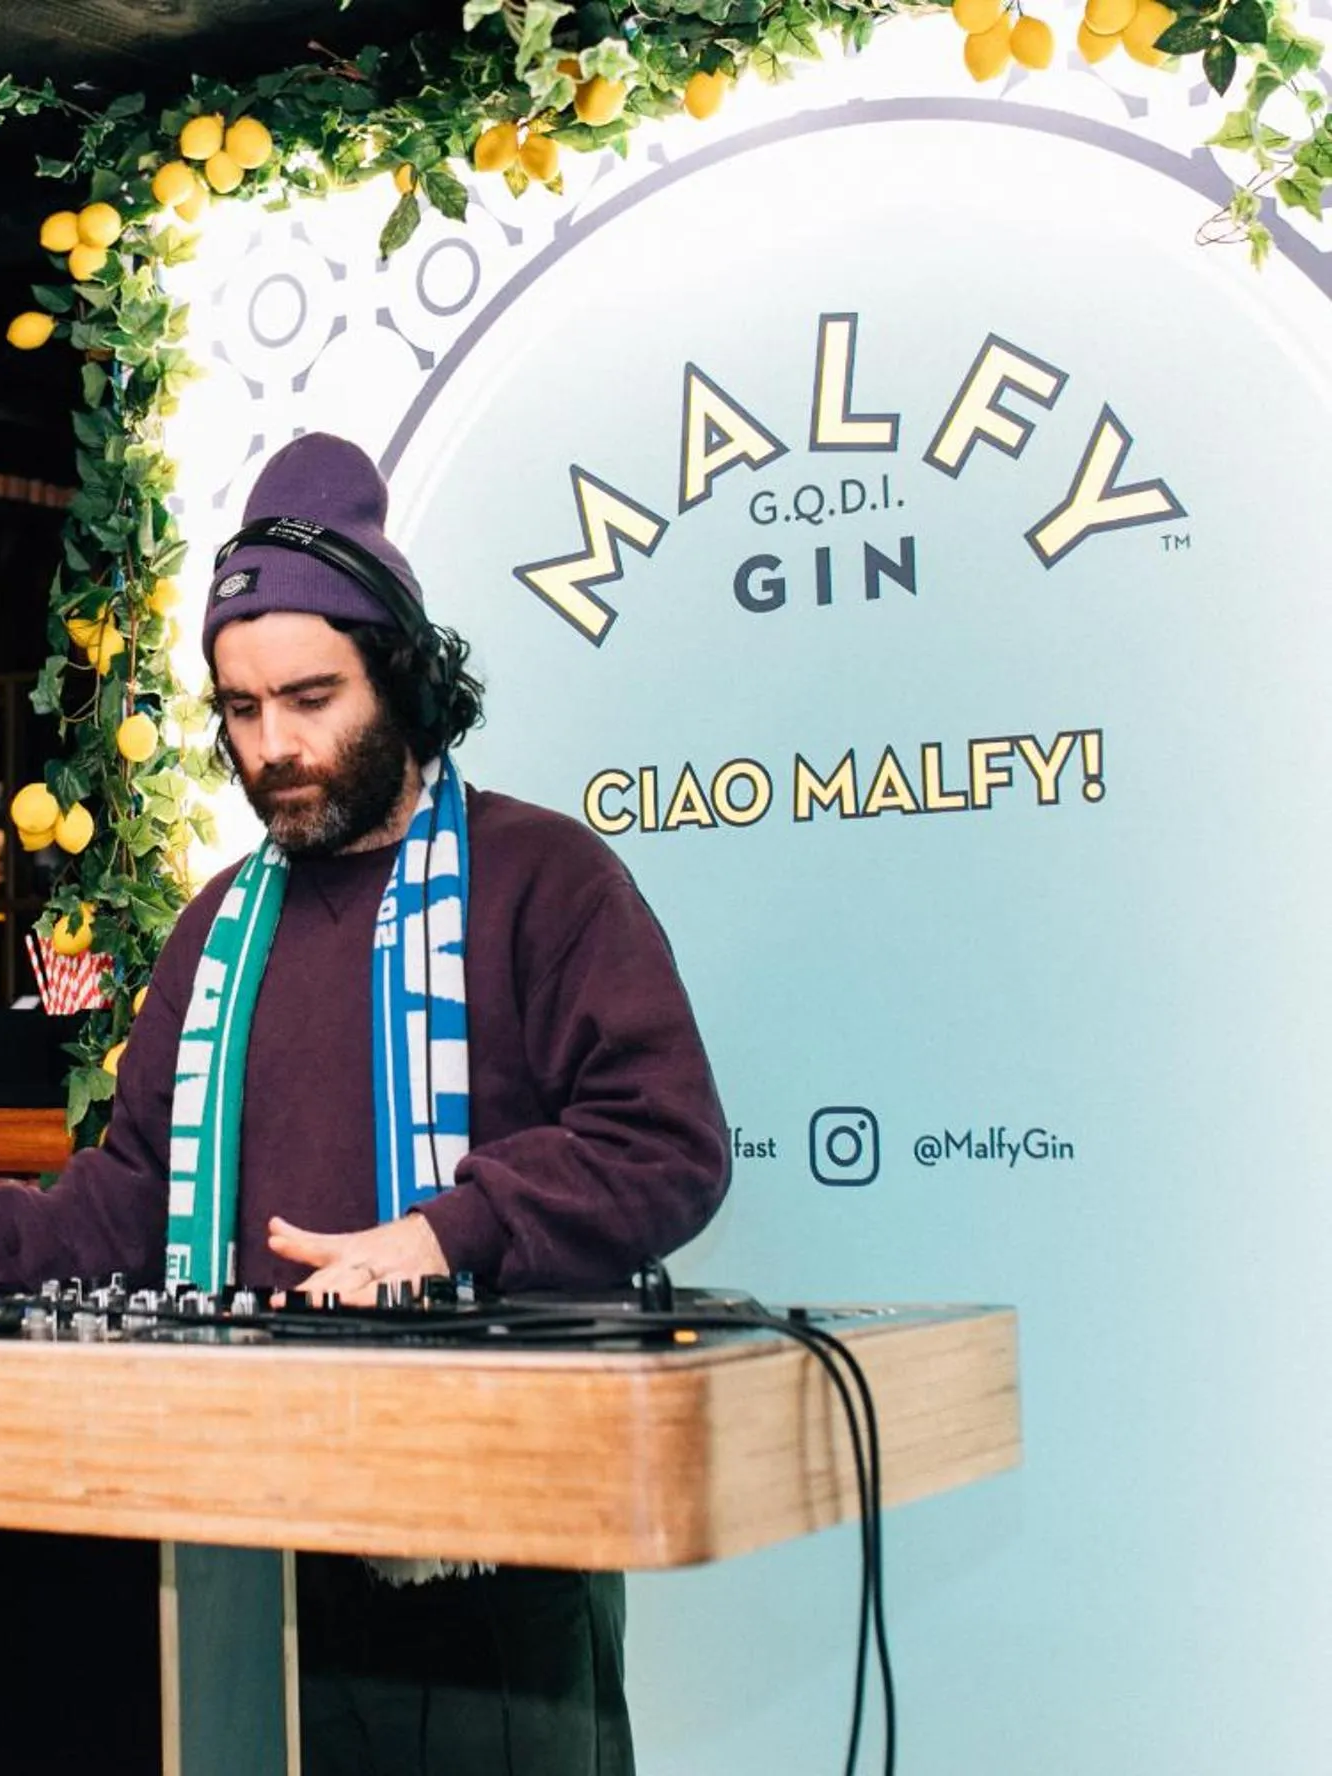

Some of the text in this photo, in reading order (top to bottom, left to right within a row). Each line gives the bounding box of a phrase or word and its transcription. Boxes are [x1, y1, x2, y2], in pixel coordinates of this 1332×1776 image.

[513, 312, 1189, 648] MALFY
[748, 473, 906, 526] G.Q.D.I.
[1161, 533, 1192, 551] TM
[733, 536, 918, 613] GIN
[583, 729, 1107, 835] CIAO MALFY!
[733, 1127, 776, 1158] fast
[913, 1127, 1075, 1168] @MalfyGin
